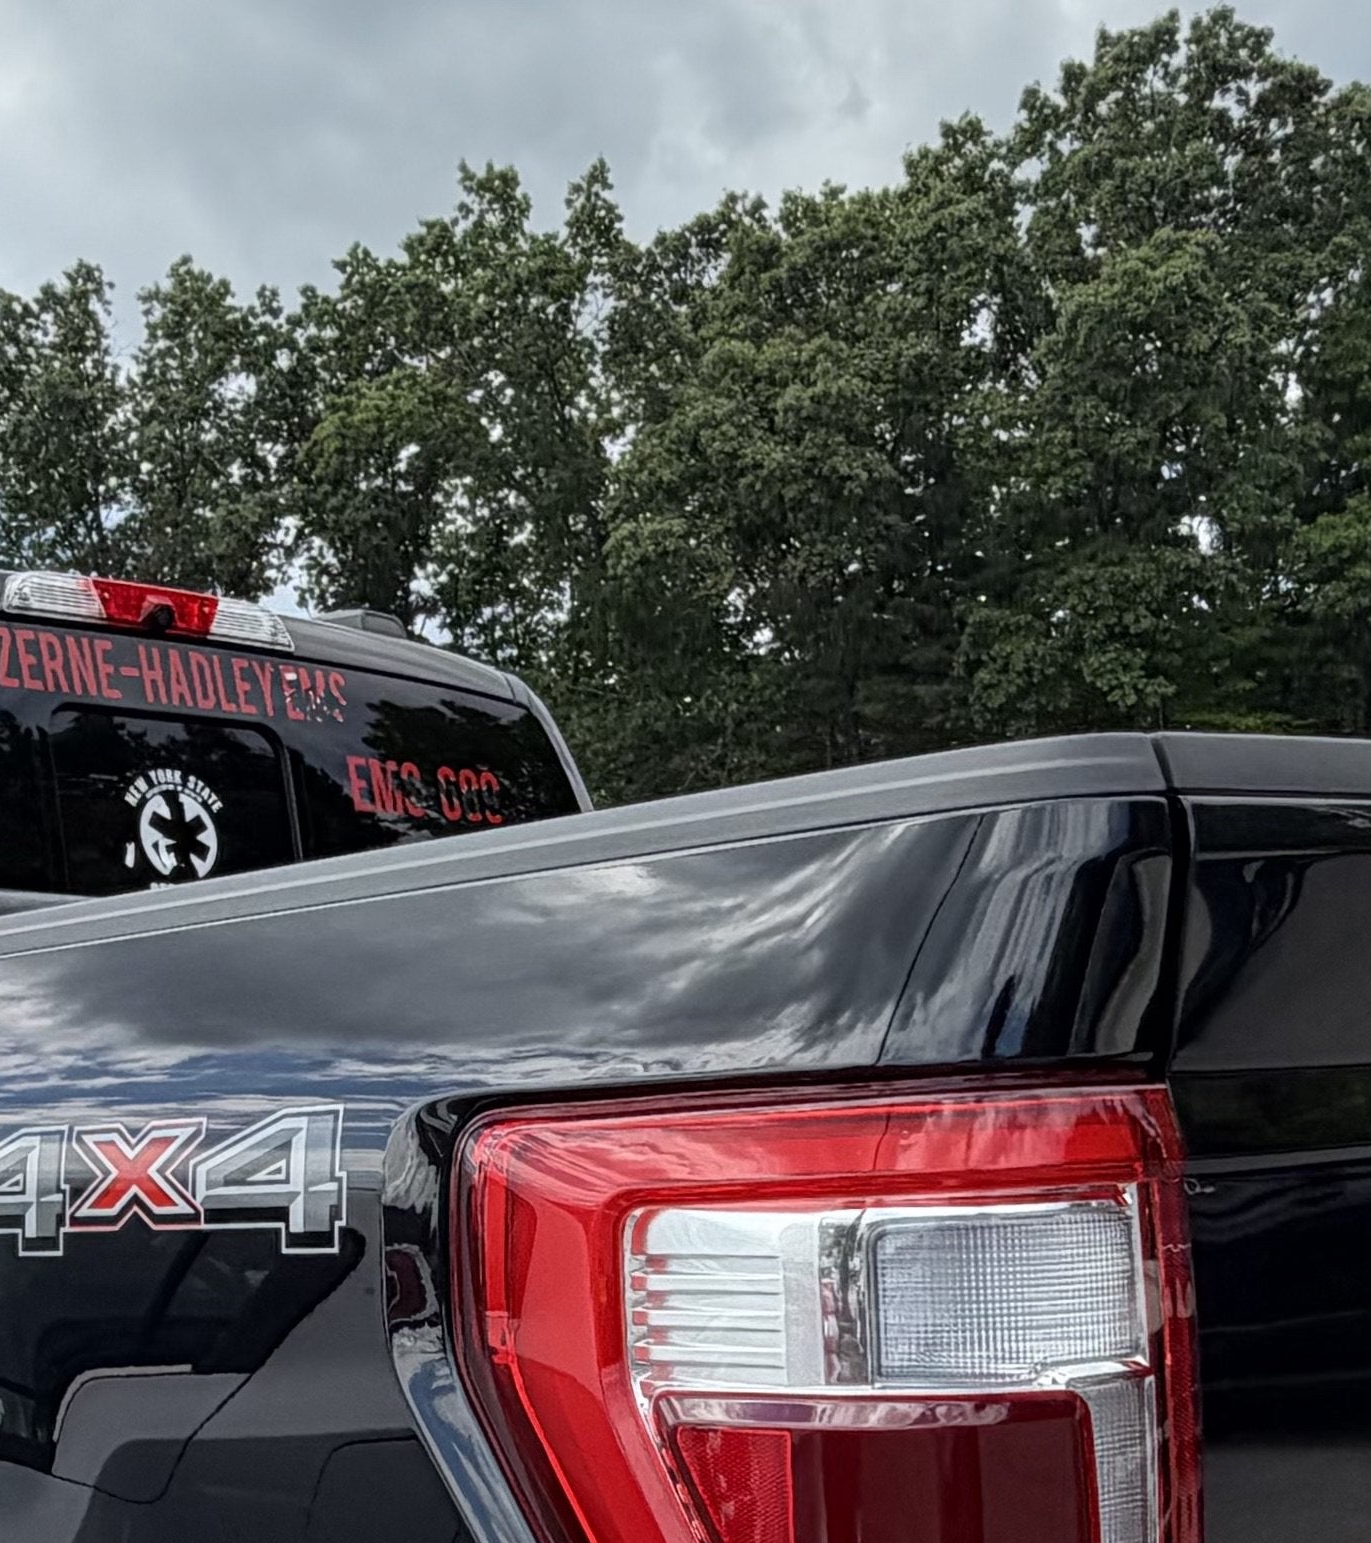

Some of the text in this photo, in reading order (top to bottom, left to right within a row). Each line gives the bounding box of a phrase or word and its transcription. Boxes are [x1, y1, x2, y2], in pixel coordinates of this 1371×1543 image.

[124, 775, 149, 807] NEW
[148, 768, 182, 785] YORK
[187, 775, 224, 813] STATE
